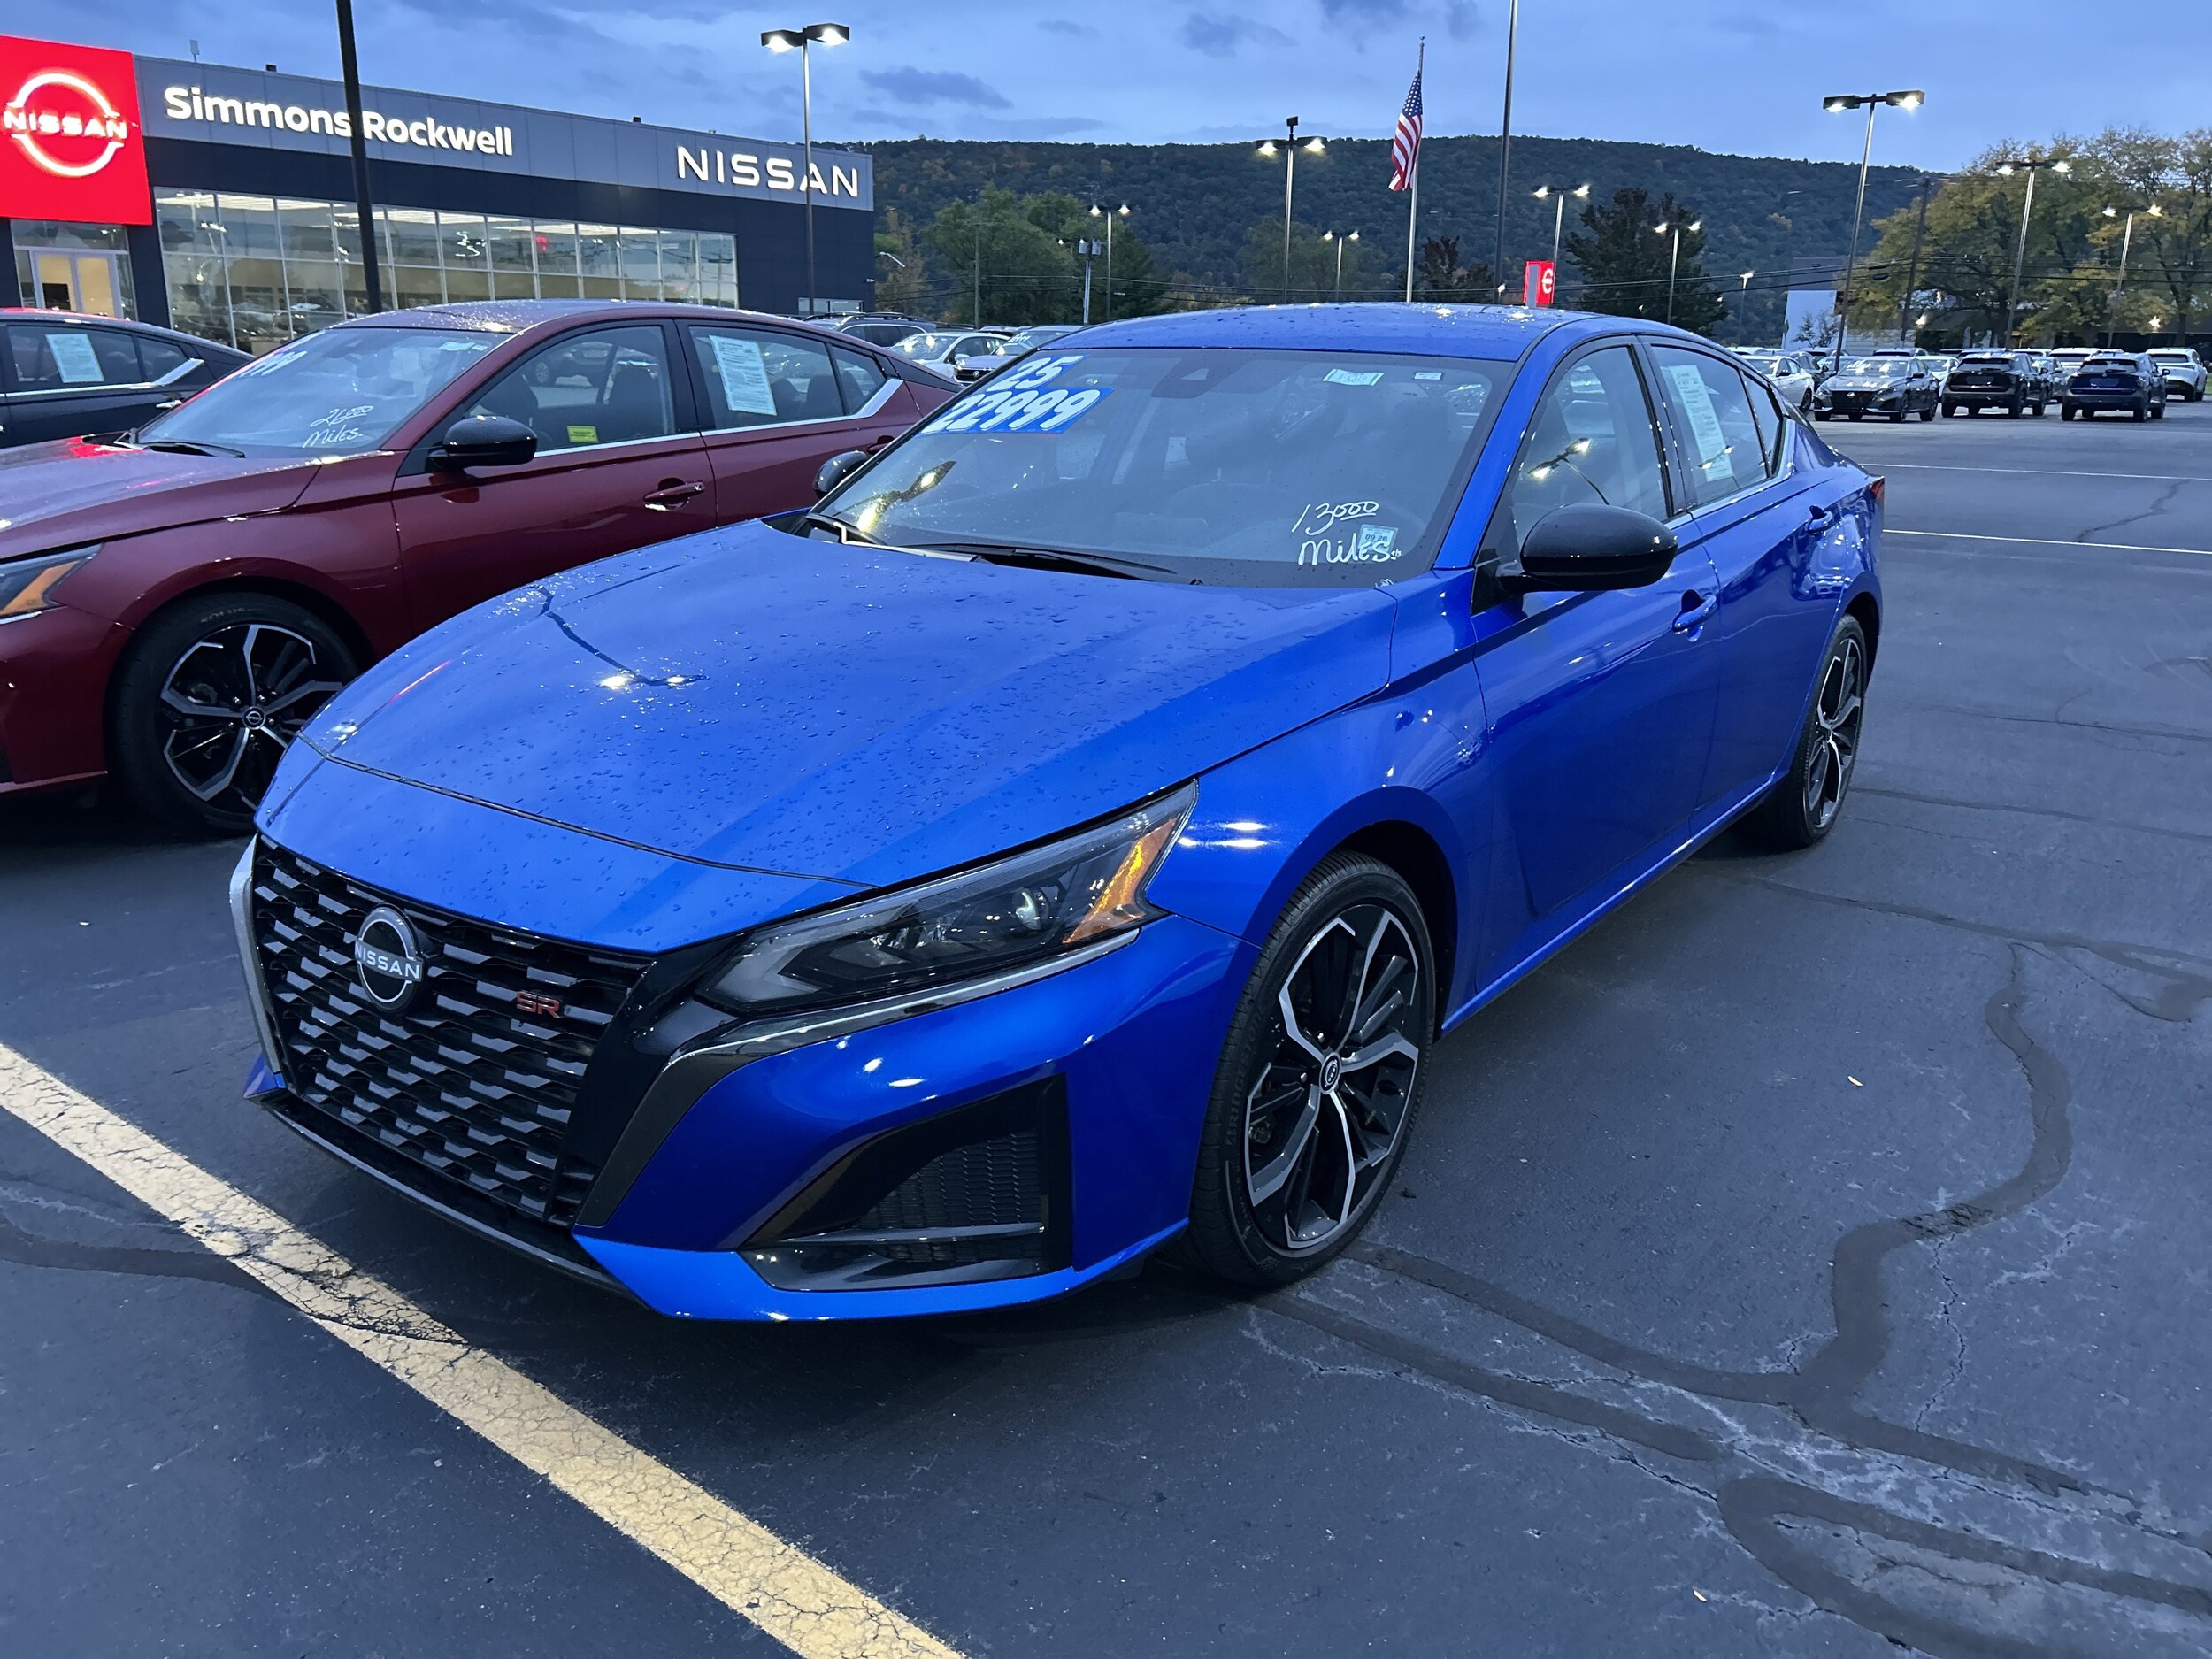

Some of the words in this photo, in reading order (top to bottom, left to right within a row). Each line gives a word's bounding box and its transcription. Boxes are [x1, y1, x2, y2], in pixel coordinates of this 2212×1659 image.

[4, 111, 127, 140] NISSAN
[165, 86, 353, 138] Simmons
[361, 110, 513, 157] Rockwell
[677, 145, 858, 197] NISSAN
[986, 355, 1085, 392] 25
[921, 389, 1101, 434] 22999
[354, 943, 421, 979] NISSAN
[516, 989, 561, 1019] SR
